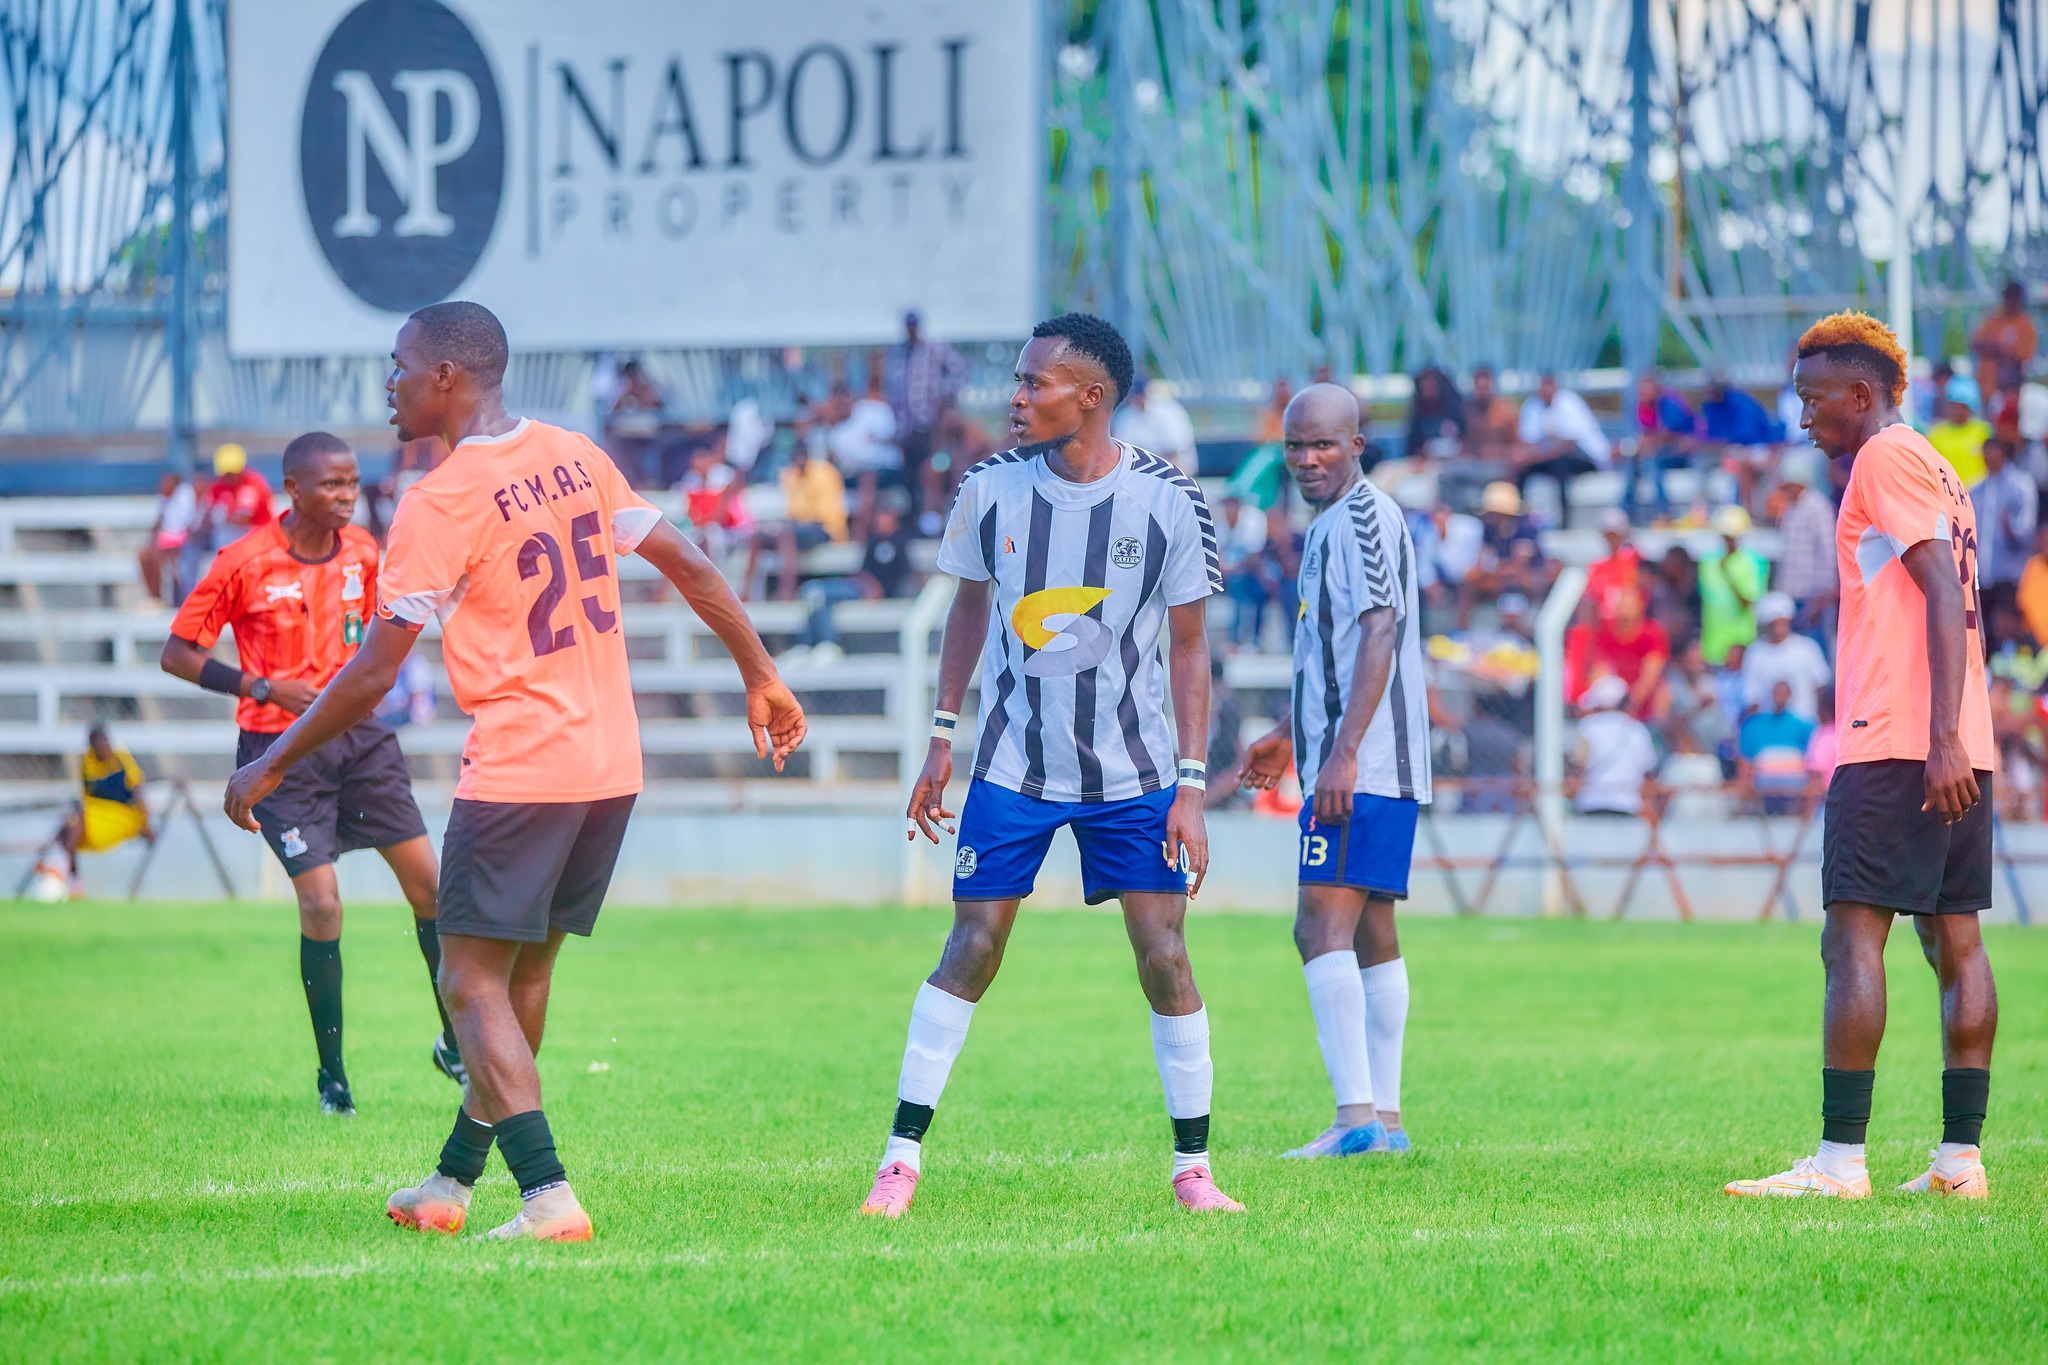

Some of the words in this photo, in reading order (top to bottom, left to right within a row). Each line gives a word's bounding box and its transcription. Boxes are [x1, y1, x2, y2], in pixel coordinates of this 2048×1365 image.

[332, 68, 482, 237] NP
[551, 36, 974, 178] NAPOLI
[551, 170, 975, 242] PROPERTY
[517, 510, 618, 657] 25
[1302, 835, 1328, 866] 13
